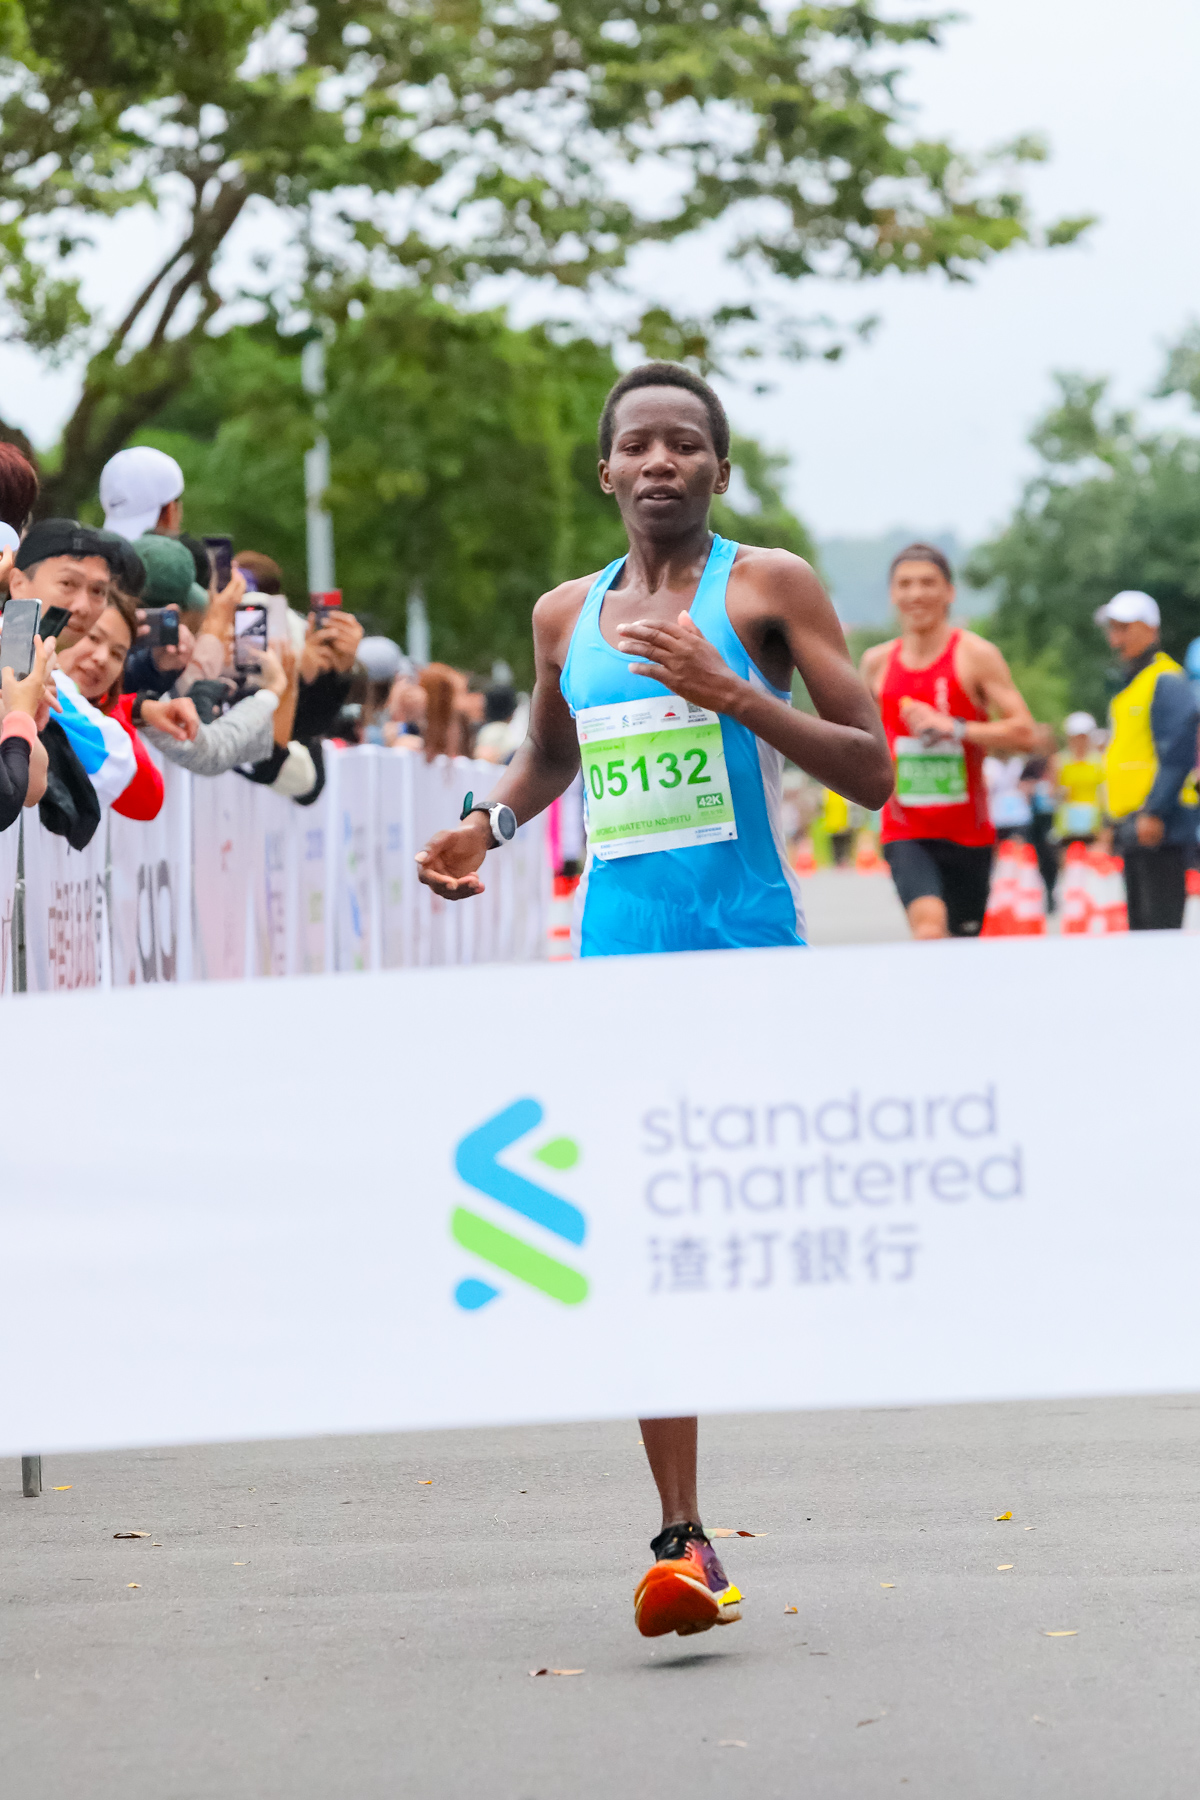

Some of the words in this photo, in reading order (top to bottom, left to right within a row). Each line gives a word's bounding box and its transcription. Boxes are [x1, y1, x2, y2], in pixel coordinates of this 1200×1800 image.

[590, 748, 711, 800] 05132
[699, 794, 722, 807] 42K
[641, 1081, 997, 1156] standard
[644, 1144, 1024, 1217] chartered
[647, 1222, 921, 1295] 渣打銀行
